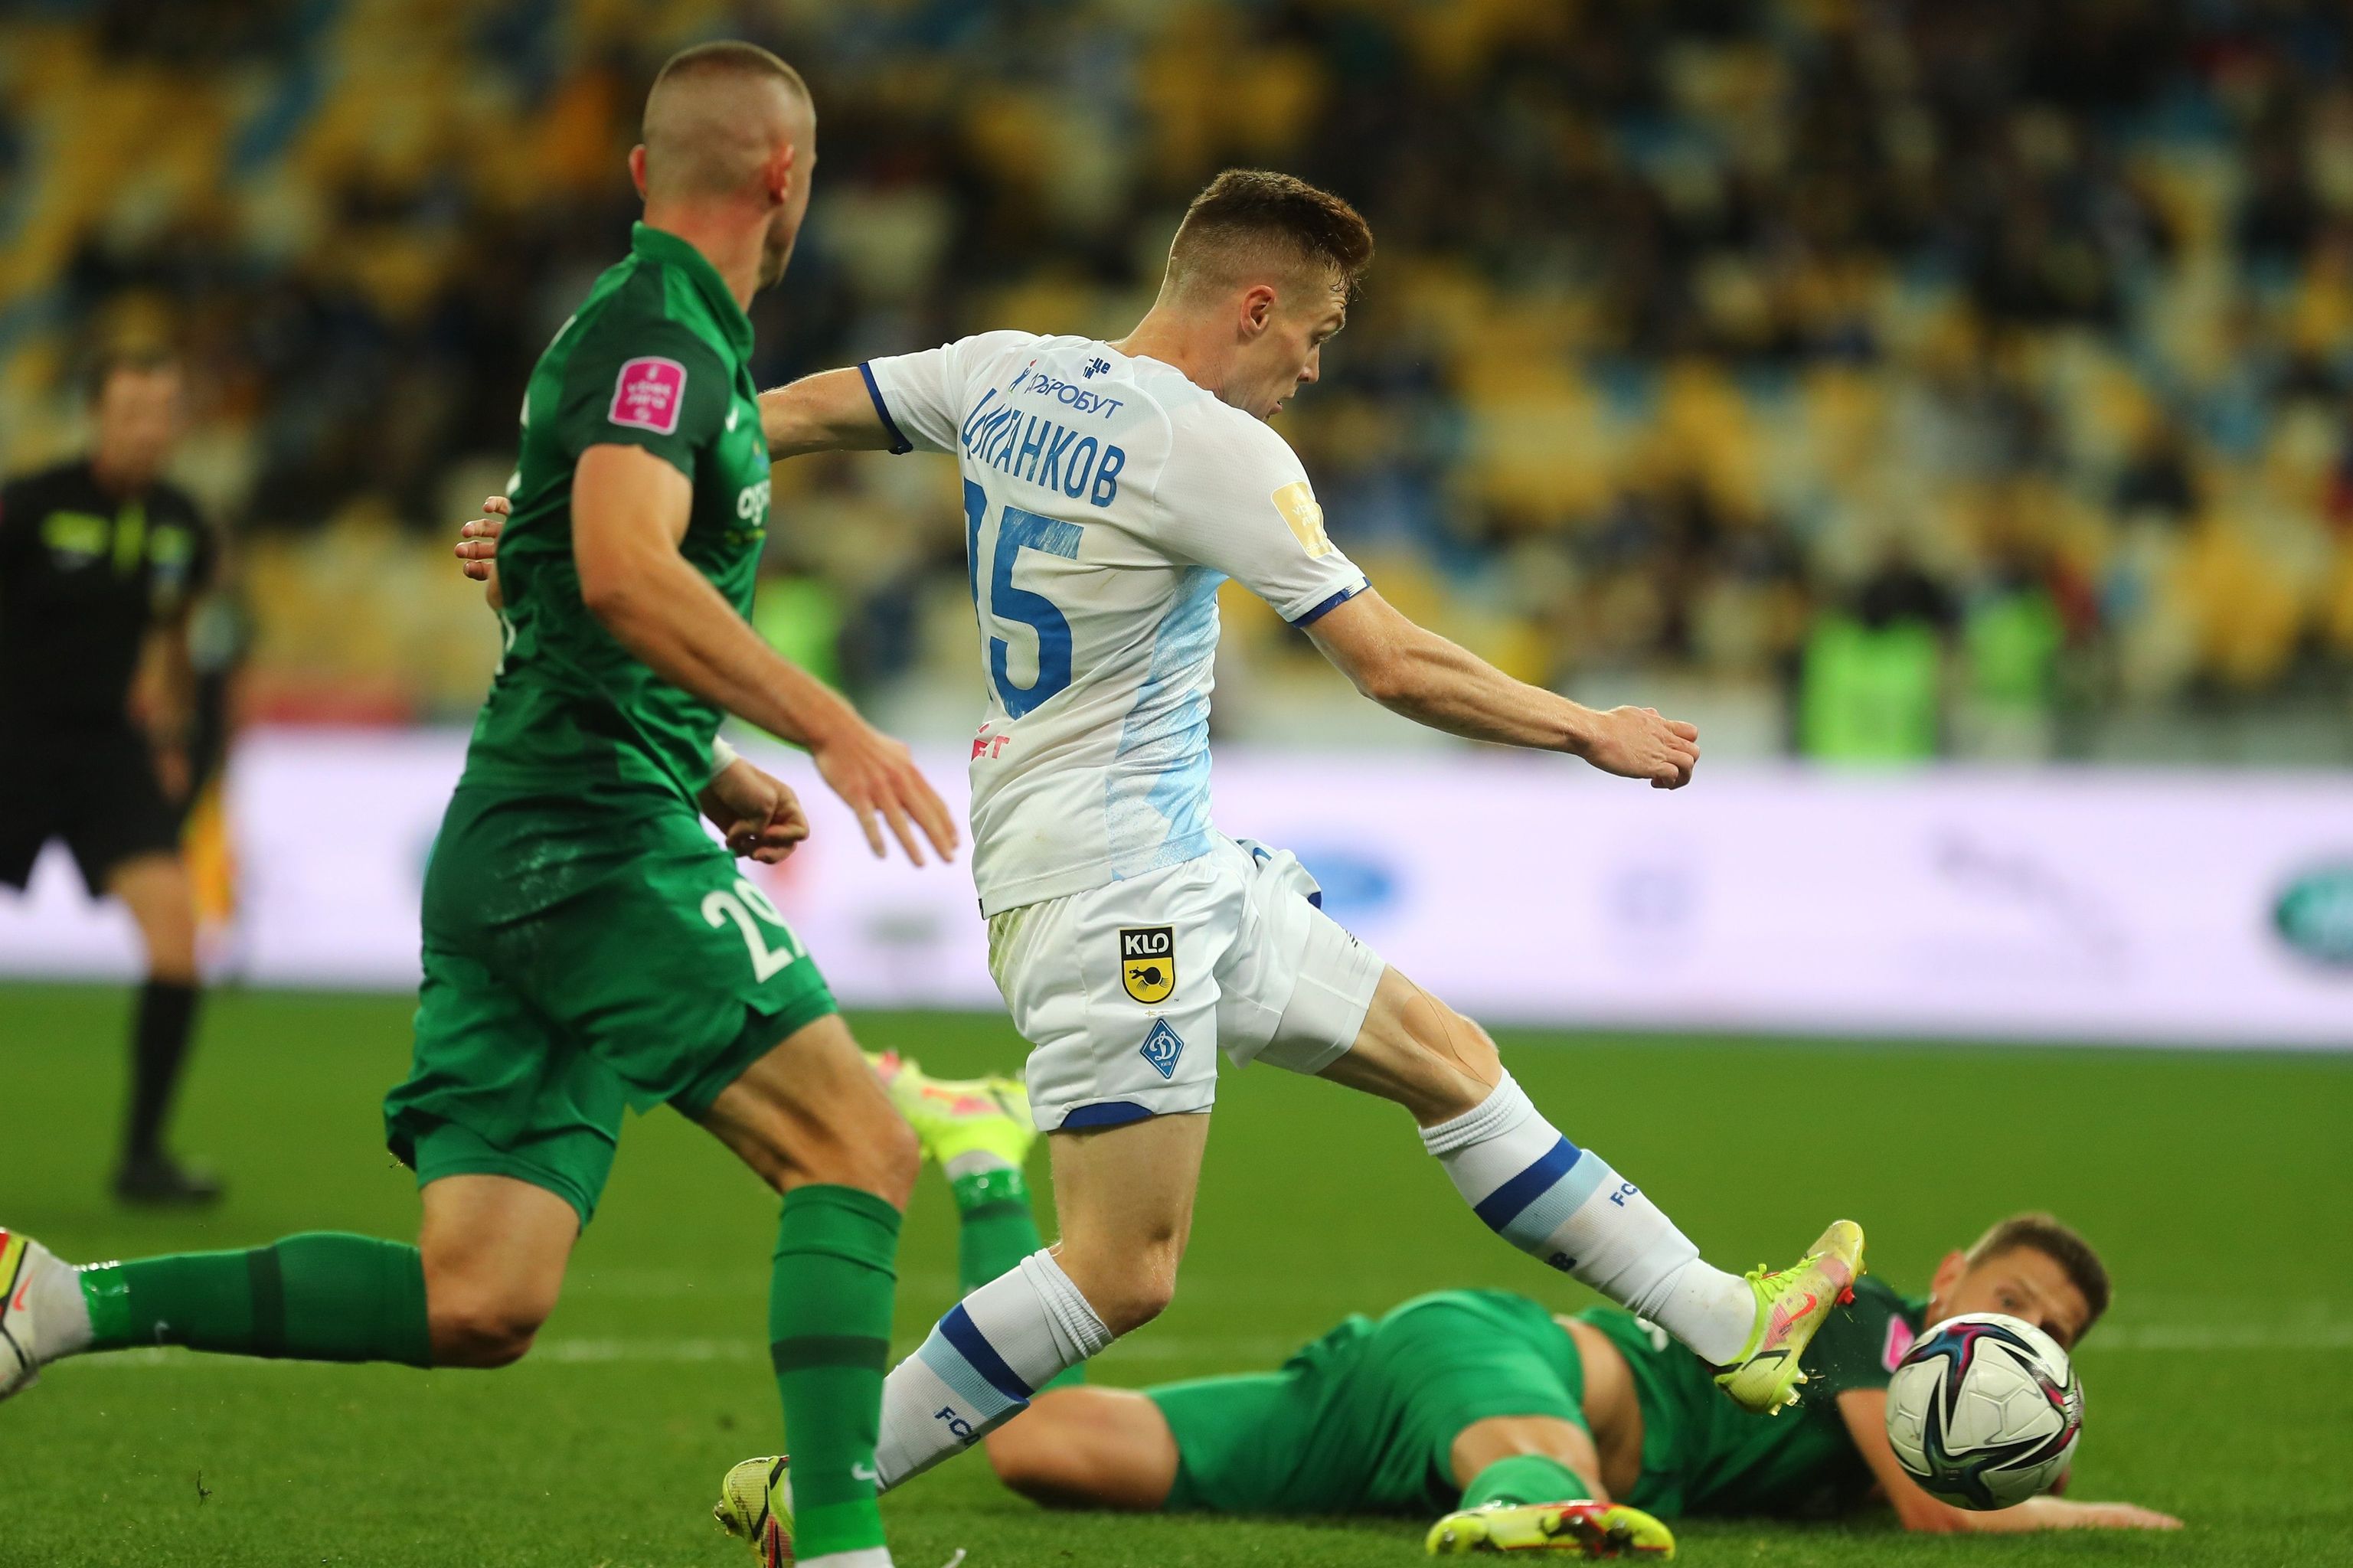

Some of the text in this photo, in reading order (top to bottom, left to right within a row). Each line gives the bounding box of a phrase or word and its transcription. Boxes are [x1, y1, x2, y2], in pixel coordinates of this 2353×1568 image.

[701, 877, 807, 985] 29
[1124, 932, 1170, 956] KLO
[1610, 1182, 1639, 1207] FC
